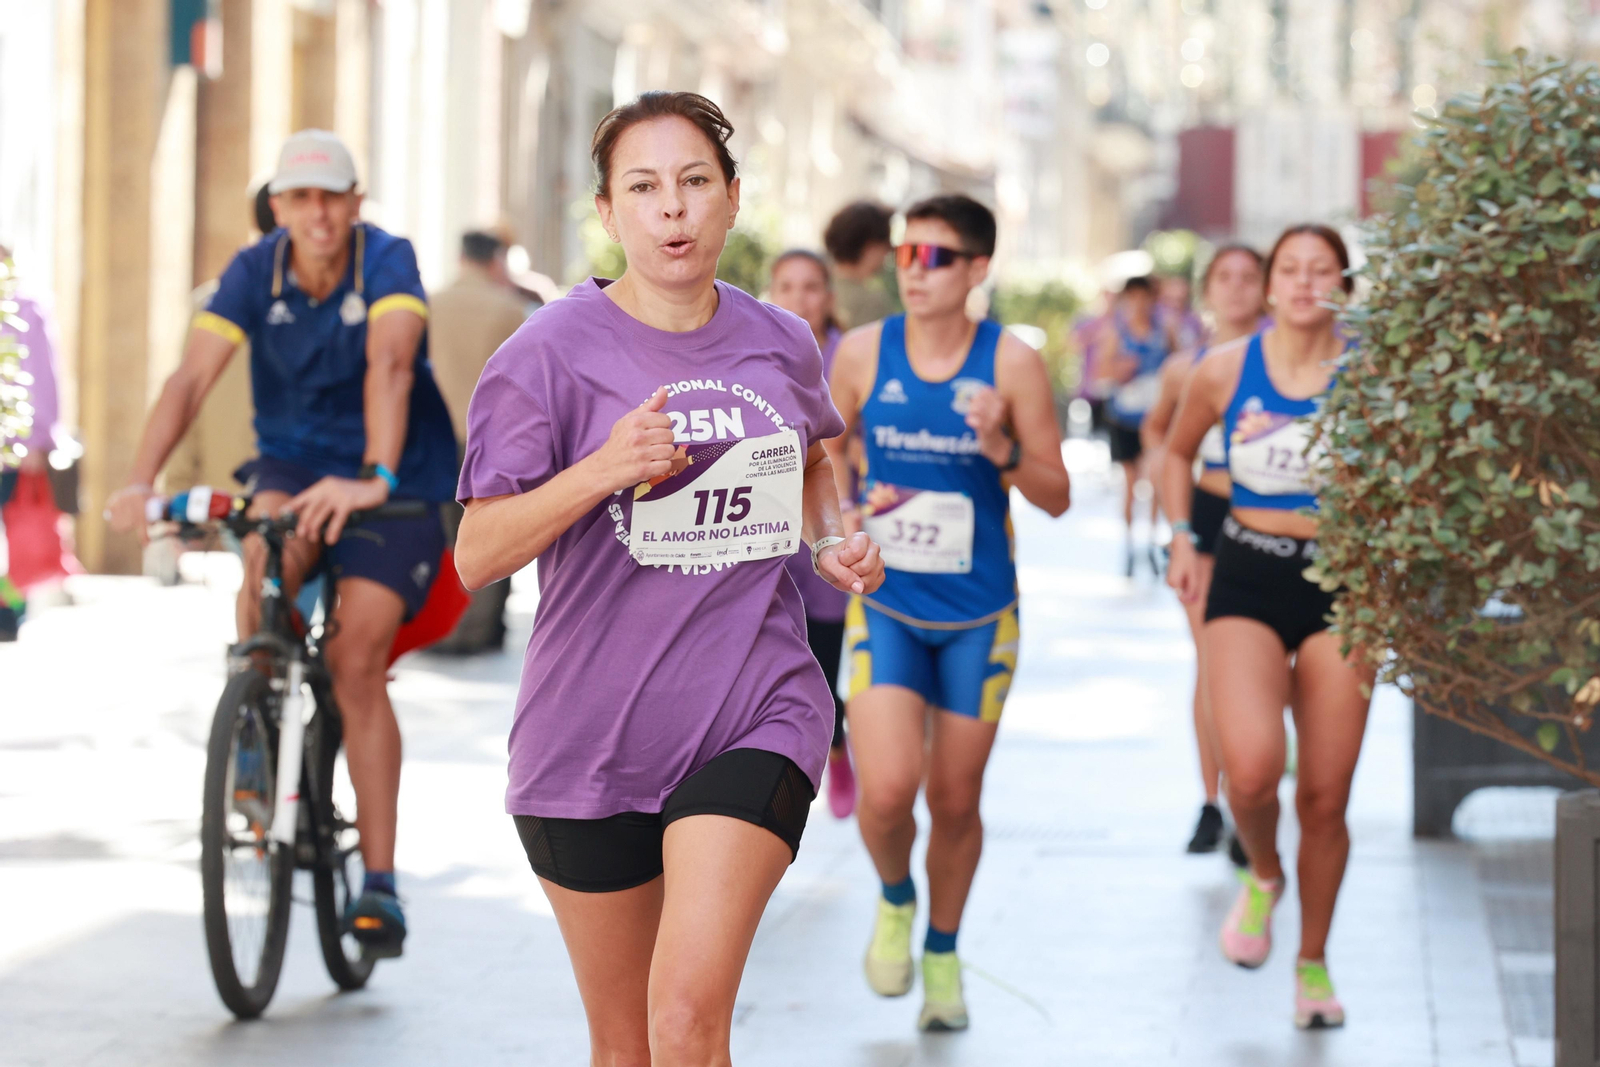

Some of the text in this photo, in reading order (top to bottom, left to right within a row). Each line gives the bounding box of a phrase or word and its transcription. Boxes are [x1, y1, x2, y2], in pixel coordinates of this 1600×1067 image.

[665, 407, 746, 443] 25N
[751, 444, 796, 461] CARRERA
[745, 471, 767, 479] CONTRA
[777, 466, 797, 474] MUJERES
[772, 460, 797, 469] VIOLENCIA
[693, 486, 753, 526] 115
[642, 520, 790, 542] EL AMOR NO LASTIMA
